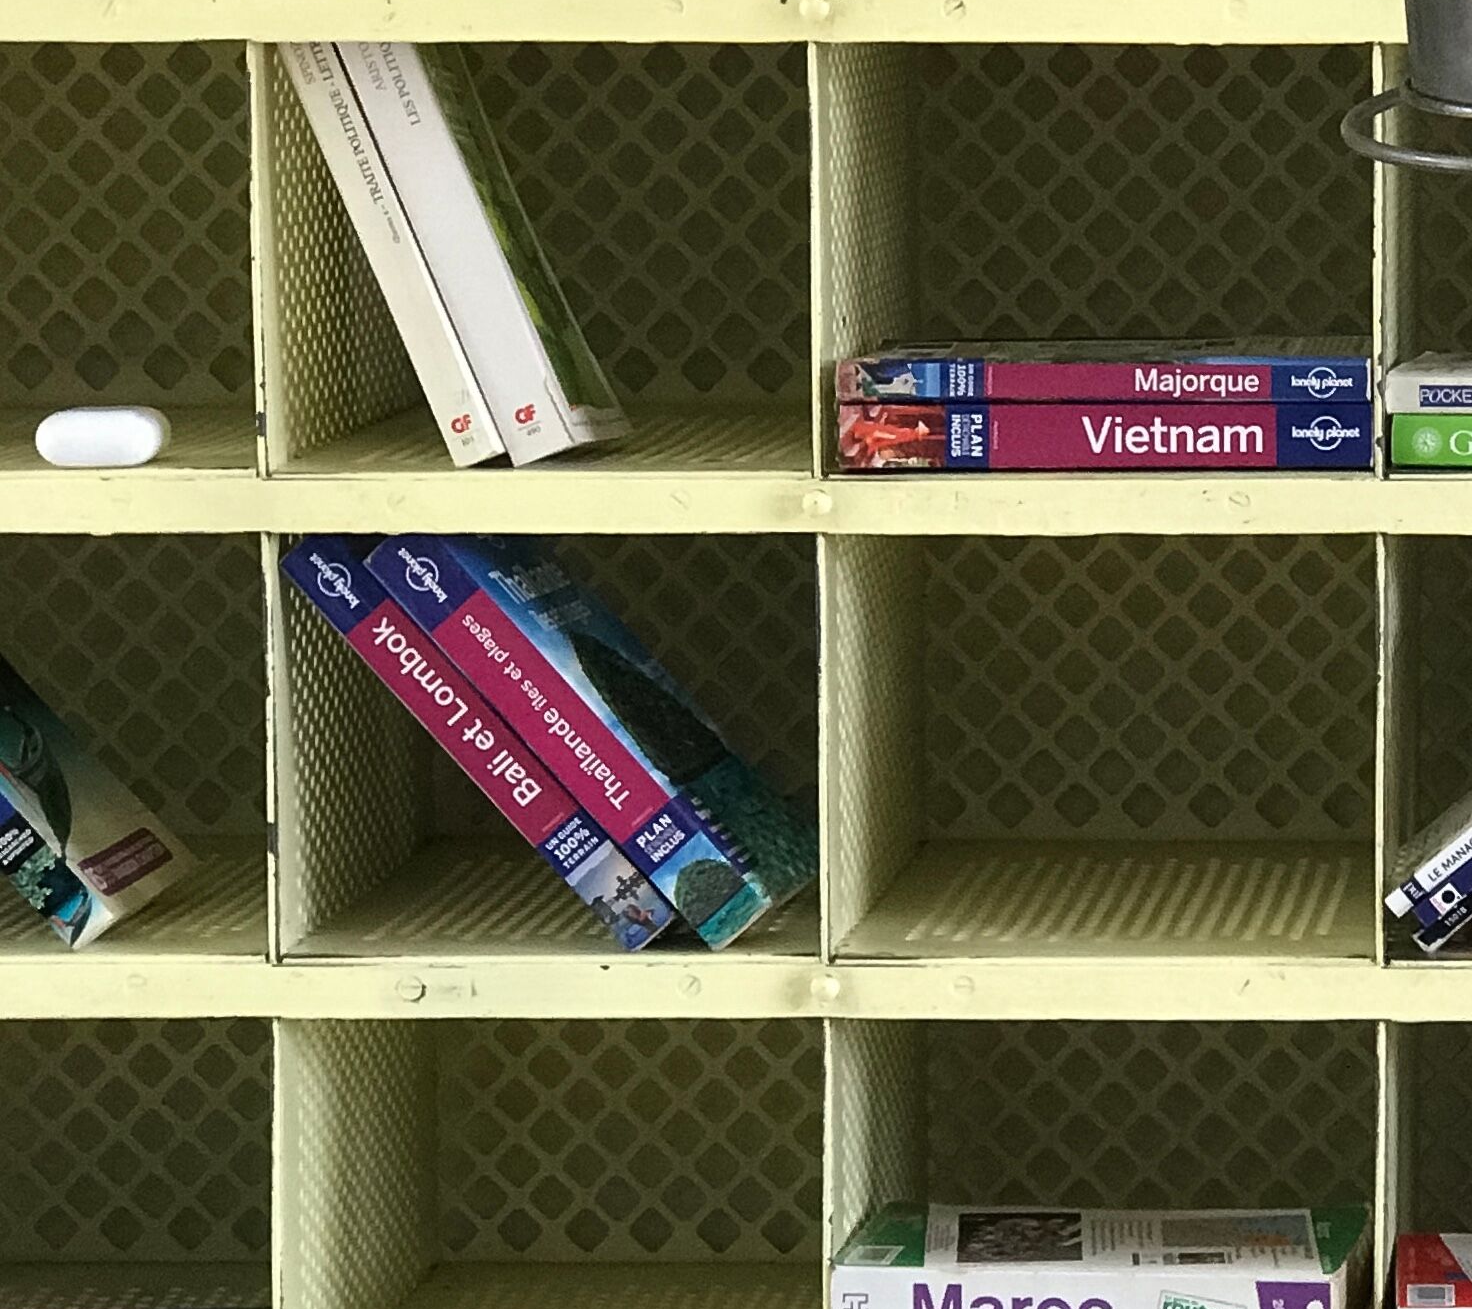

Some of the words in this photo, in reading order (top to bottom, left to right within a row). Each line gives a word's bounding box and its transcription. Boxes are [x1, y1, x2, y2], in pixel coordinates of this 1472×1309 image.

[329, 88, 365, 157] POLITIQUE
[403, 99, 421, 126] LES
[957, 364, 966, 396] 100%
[1135, 368, 1260, 398] Majorque
[1291, 375, 1321, 390] lonely
[1322, 376, 1353, 390] planet
[450, 414, 472, 434] GF
[514, 403, 537, 425] GF
[951, 414, 961, 457] INCLUS
[971, 414, 983, 456] PLAN
[1082, 416, 1263, 453] Vietnam
[1292, 426, 1325, 441] lonely
[1326, 426, 1360, 440] planet
[462, 614, 510, 658] plages
[372, 617, 468, 726] Lombok
[503, 661, 523, 681] et
[462, 718, 495, 750] et
[543, 707, 630, 811] Thaïlande
[486, 749, 543, 808] Bali
[553, 828, 590, 860] 100%
[636, 814, 673, 849] PLAN
[650, 831, 686, 863] INCLUS
[562, 836, 599, 870] TERRAIN
[1428, 868, 1442, 882] LE
